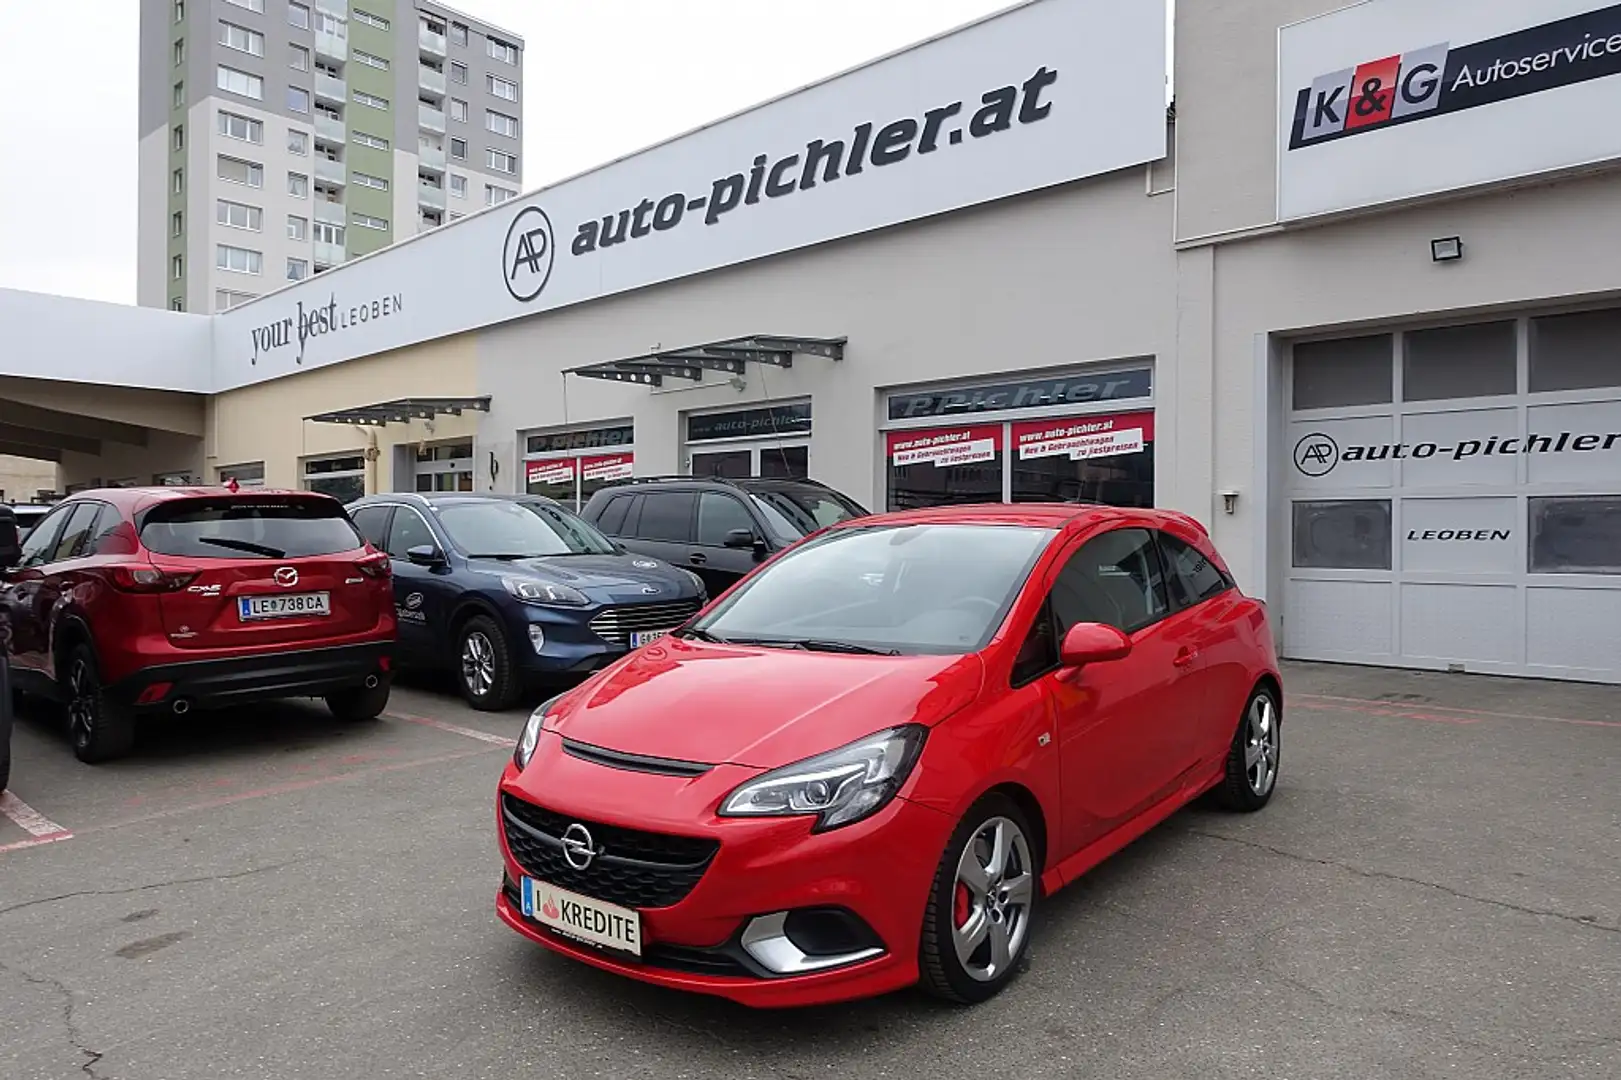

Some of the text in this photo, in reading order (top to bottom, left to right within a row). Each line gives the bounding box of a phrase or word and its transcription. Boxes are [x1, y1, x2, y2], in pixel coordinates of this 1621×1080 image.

[1451, 33, 1621, 91] Autoservice
[571, 66, 1057, 256] auto-pichler.at
[251, 317, 293, 365] your
[341, 293, 402, 328] LEOBEN
[1342, 432, 1621, 460] auto-pichler
[1407, 529, 1510, 541] LEOBEN
[279, 597, 303, 611] 738
[307, 596, 324, 610] CA
[561, 899, 635, 943] KREDITE
